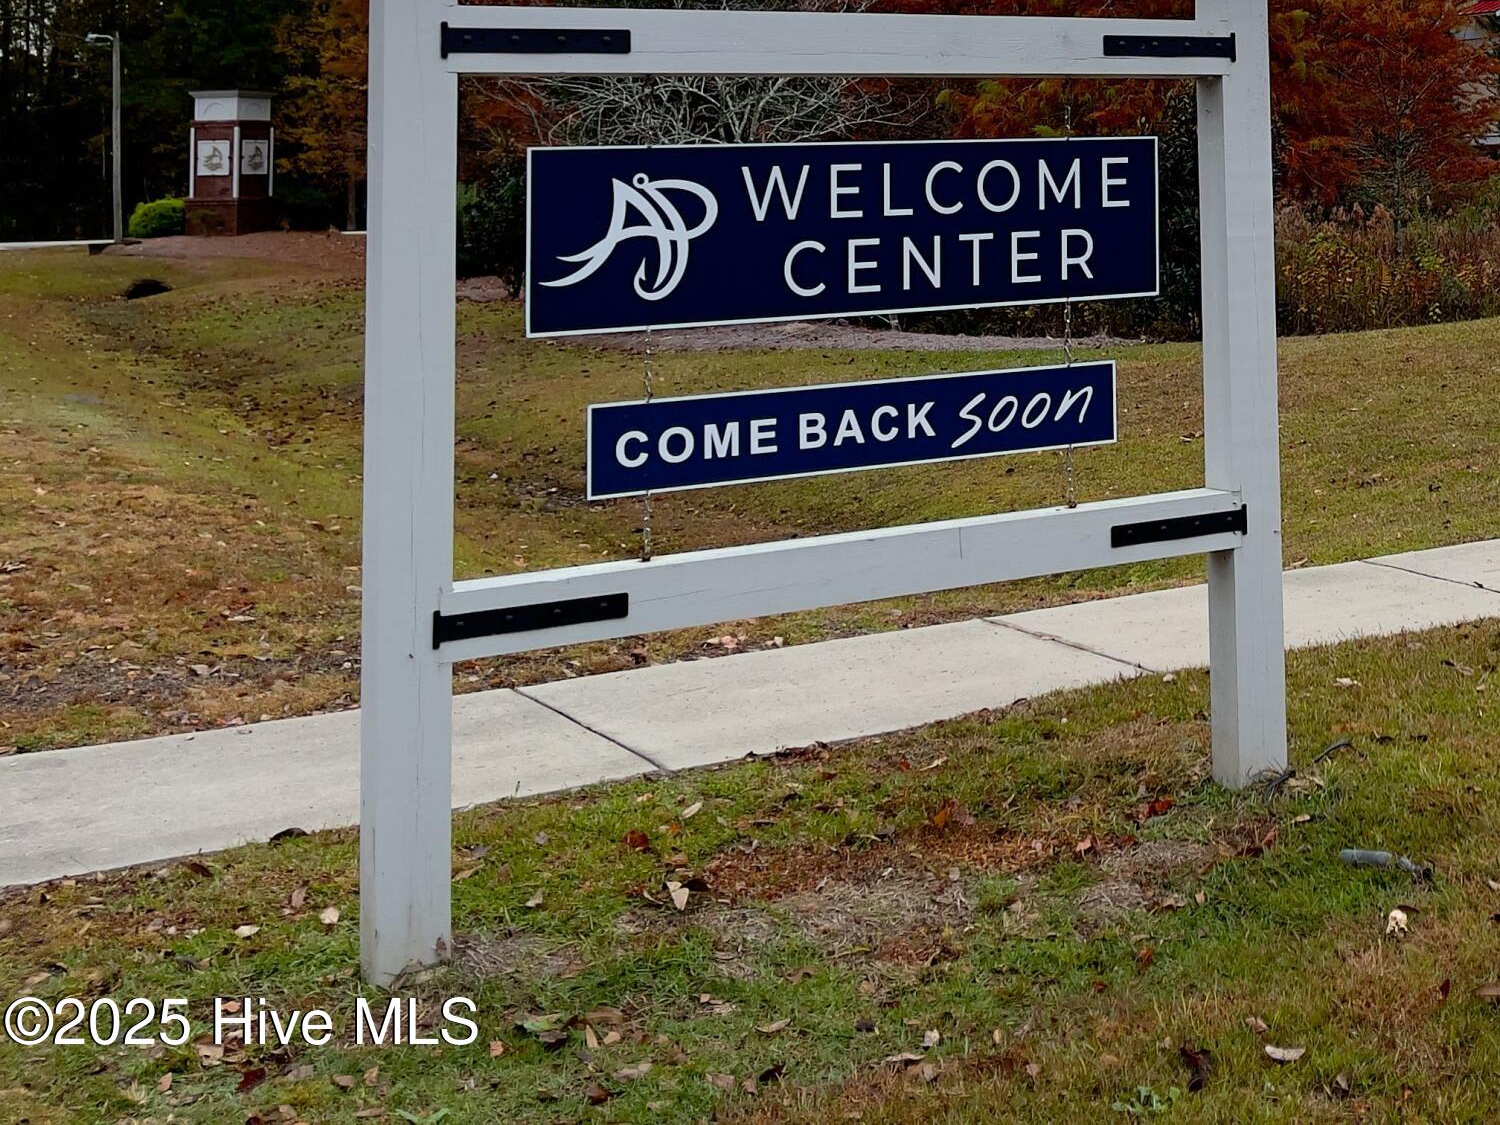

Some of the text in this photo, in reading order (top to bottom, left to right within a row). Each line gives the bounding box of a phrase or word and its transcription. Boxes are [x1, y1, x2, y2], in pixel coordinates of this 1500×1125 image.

[741, 156, 1131, 222] WELCOME
[783, 228, 1094, 297] CENTER
[615, 417, 778, 468] COME
[799, 401, 936, 450] BACK
